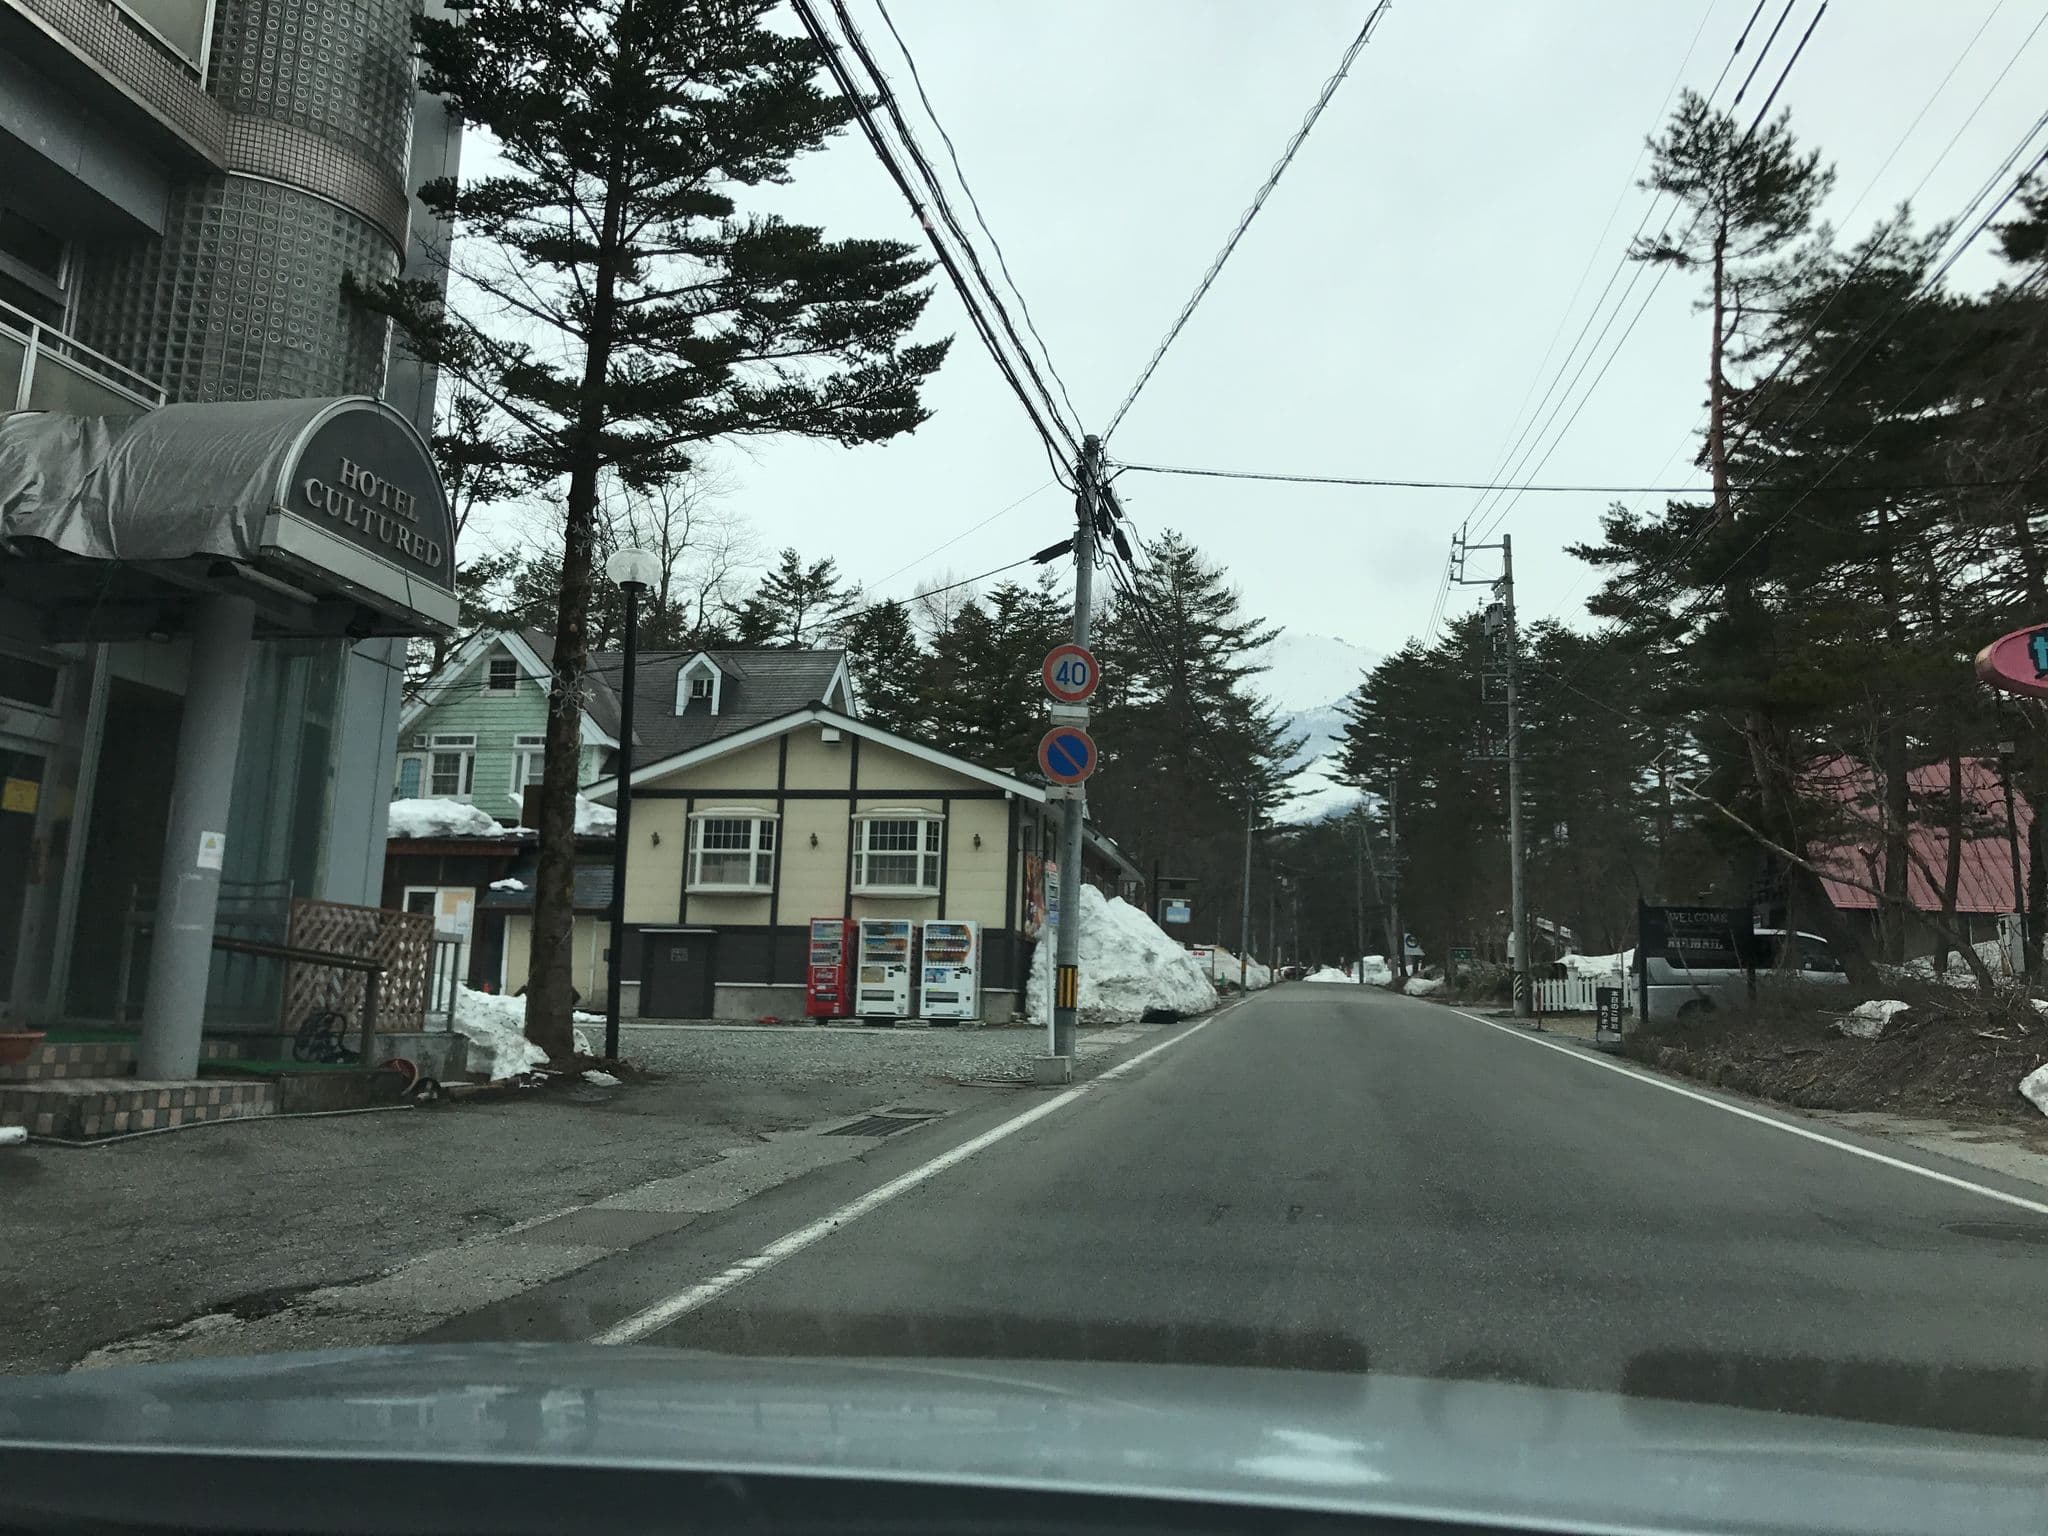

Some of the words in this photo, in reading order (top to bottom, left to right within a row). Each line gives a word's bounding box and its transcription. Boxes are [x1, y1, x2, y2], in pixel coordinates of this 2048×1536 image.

[339, 457, 419, 523] HOTEL
[304, 478, 442, 567] CULTURED
[1056, 661, 1086, 685] 40
[1668, 911, 1729, 924] WELCOME
